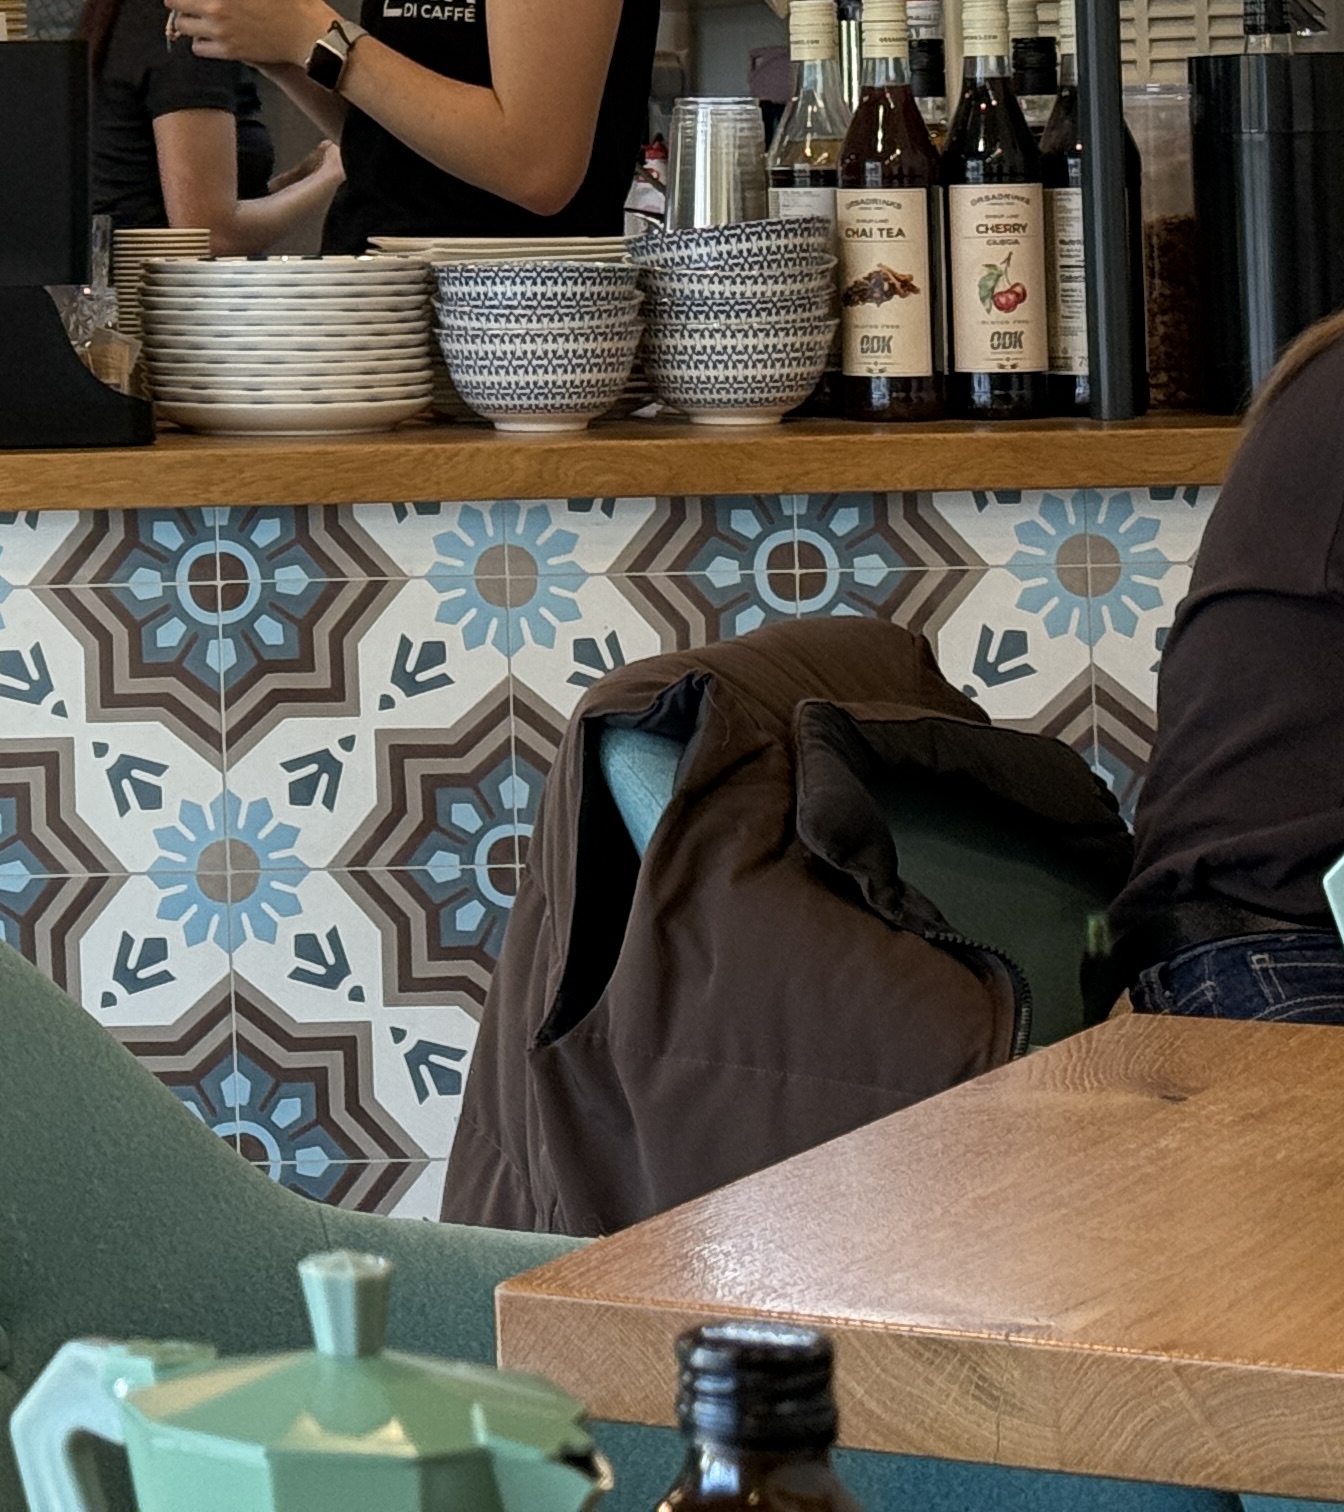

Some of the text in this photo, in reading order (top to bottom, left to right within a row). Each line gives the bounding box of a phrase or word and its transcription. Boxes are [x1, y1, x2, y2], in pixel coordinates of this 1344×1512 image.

[403, 3, 418, 18] DI
[877, 228, 906, 238] TEA
[976, 223, 1028, 234] CHERRY
